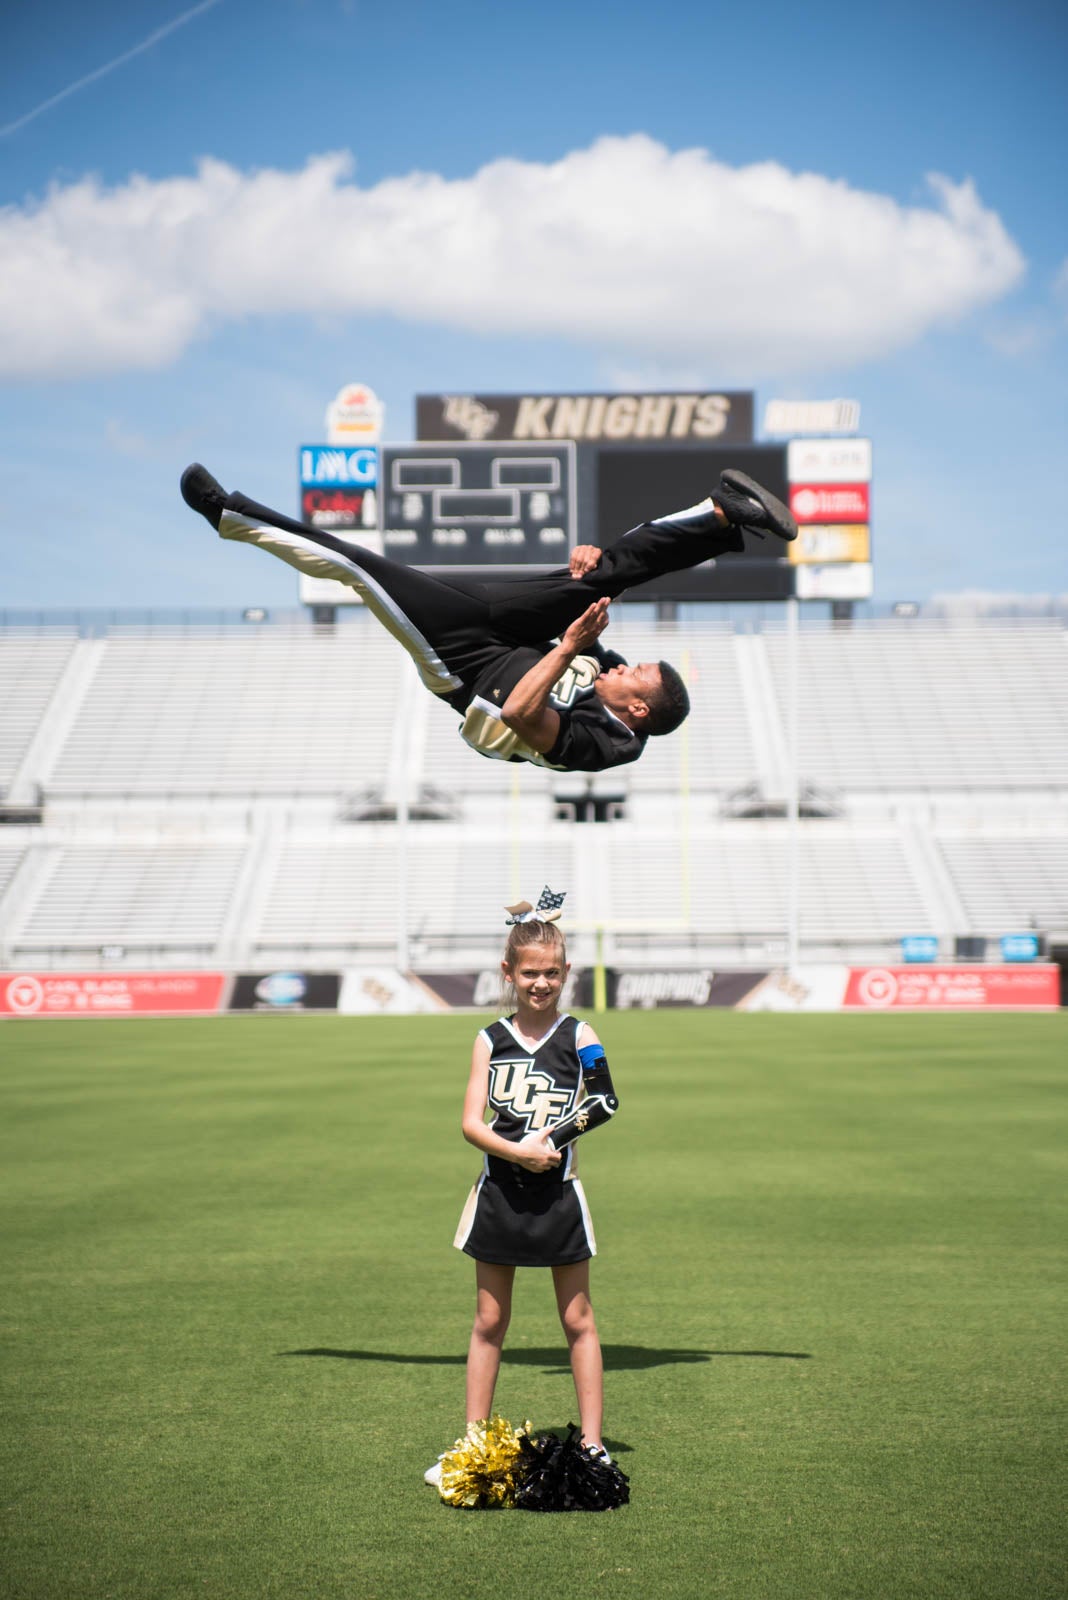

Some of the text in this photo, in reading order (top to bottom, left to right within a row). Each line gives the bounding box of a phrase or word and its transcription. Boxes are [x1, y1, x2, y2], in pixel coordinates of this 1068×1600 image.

[514, 395, 730, 438] KNIGHTS
[302, 449, 376, 482] IMG
[489, 1059, 574, 1133] UCF
